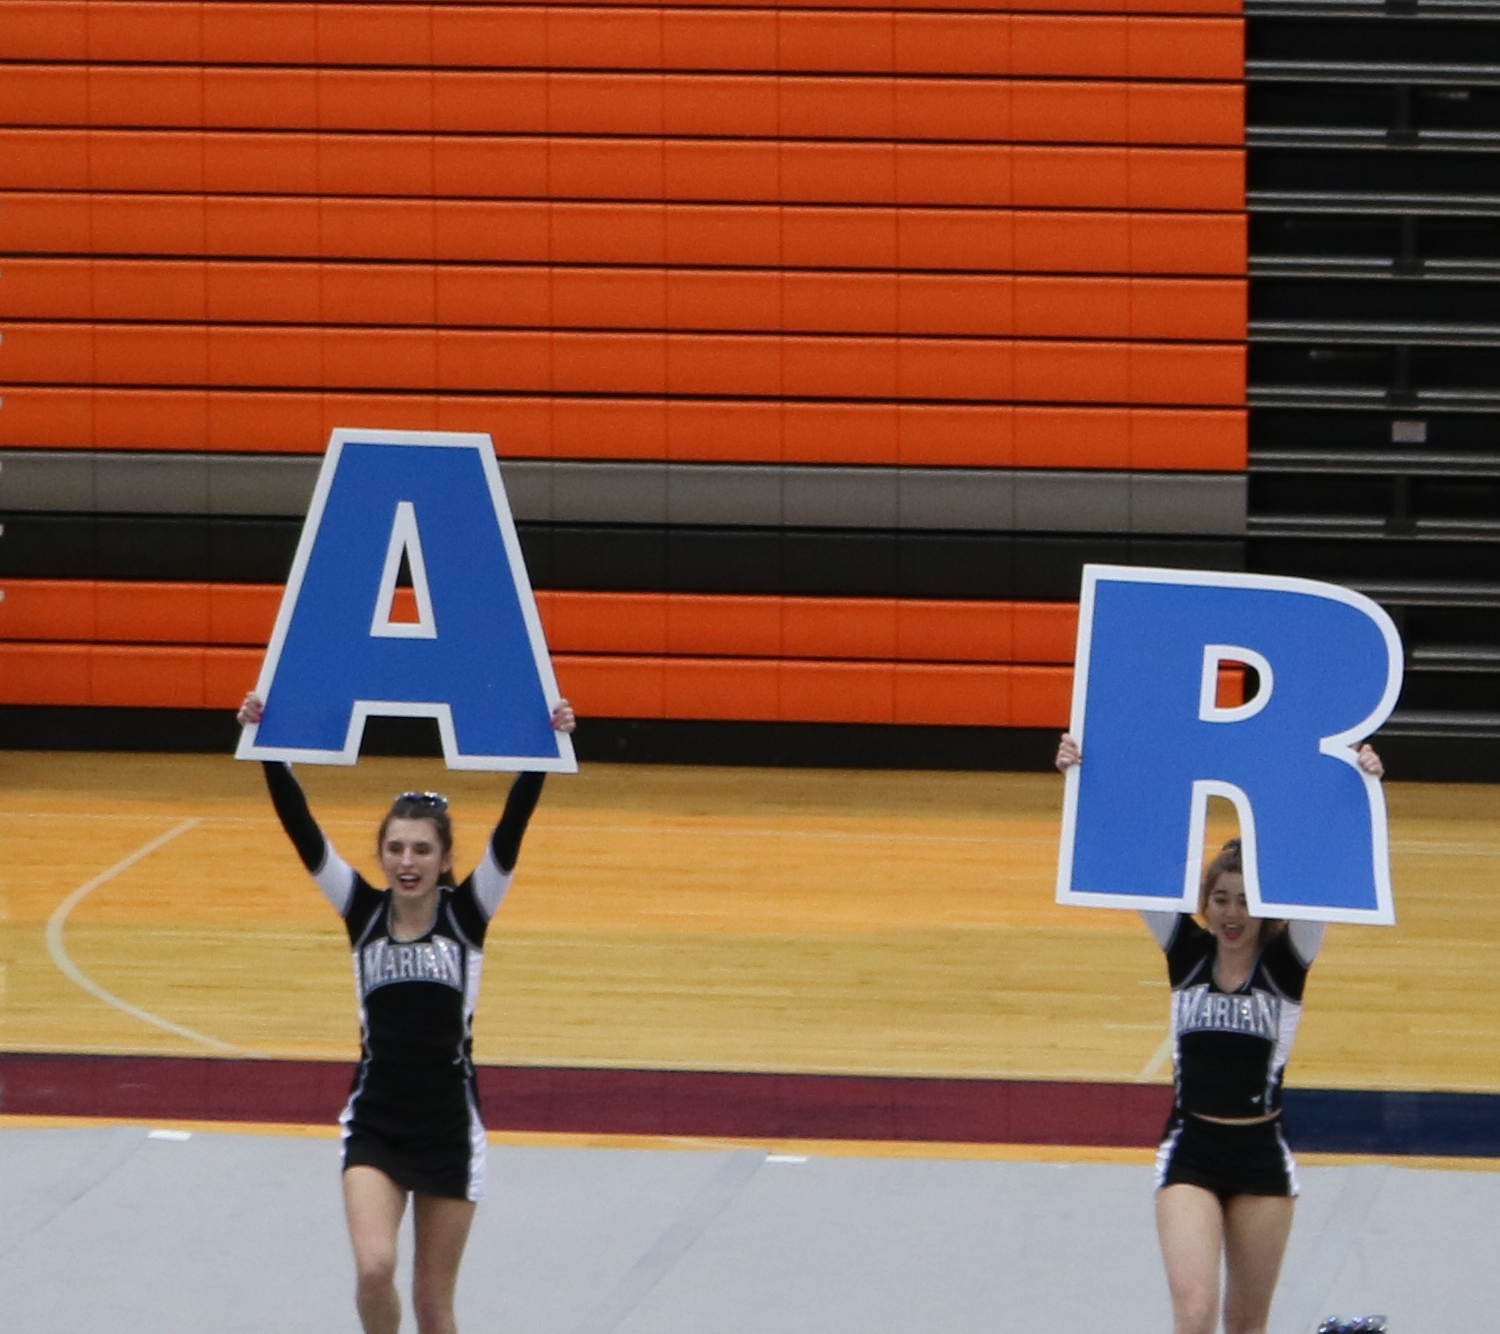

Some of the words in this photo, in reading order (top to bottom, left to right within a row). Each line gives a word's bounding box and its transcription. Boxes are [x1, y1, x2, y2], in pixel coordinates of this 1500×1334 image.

[233, 427, 578, 774] A
[1054, 562, 1405, 926] R
[362, 934, 463, 997] MARIAN
[1176, 983, 1280, 1042] MARIAN
